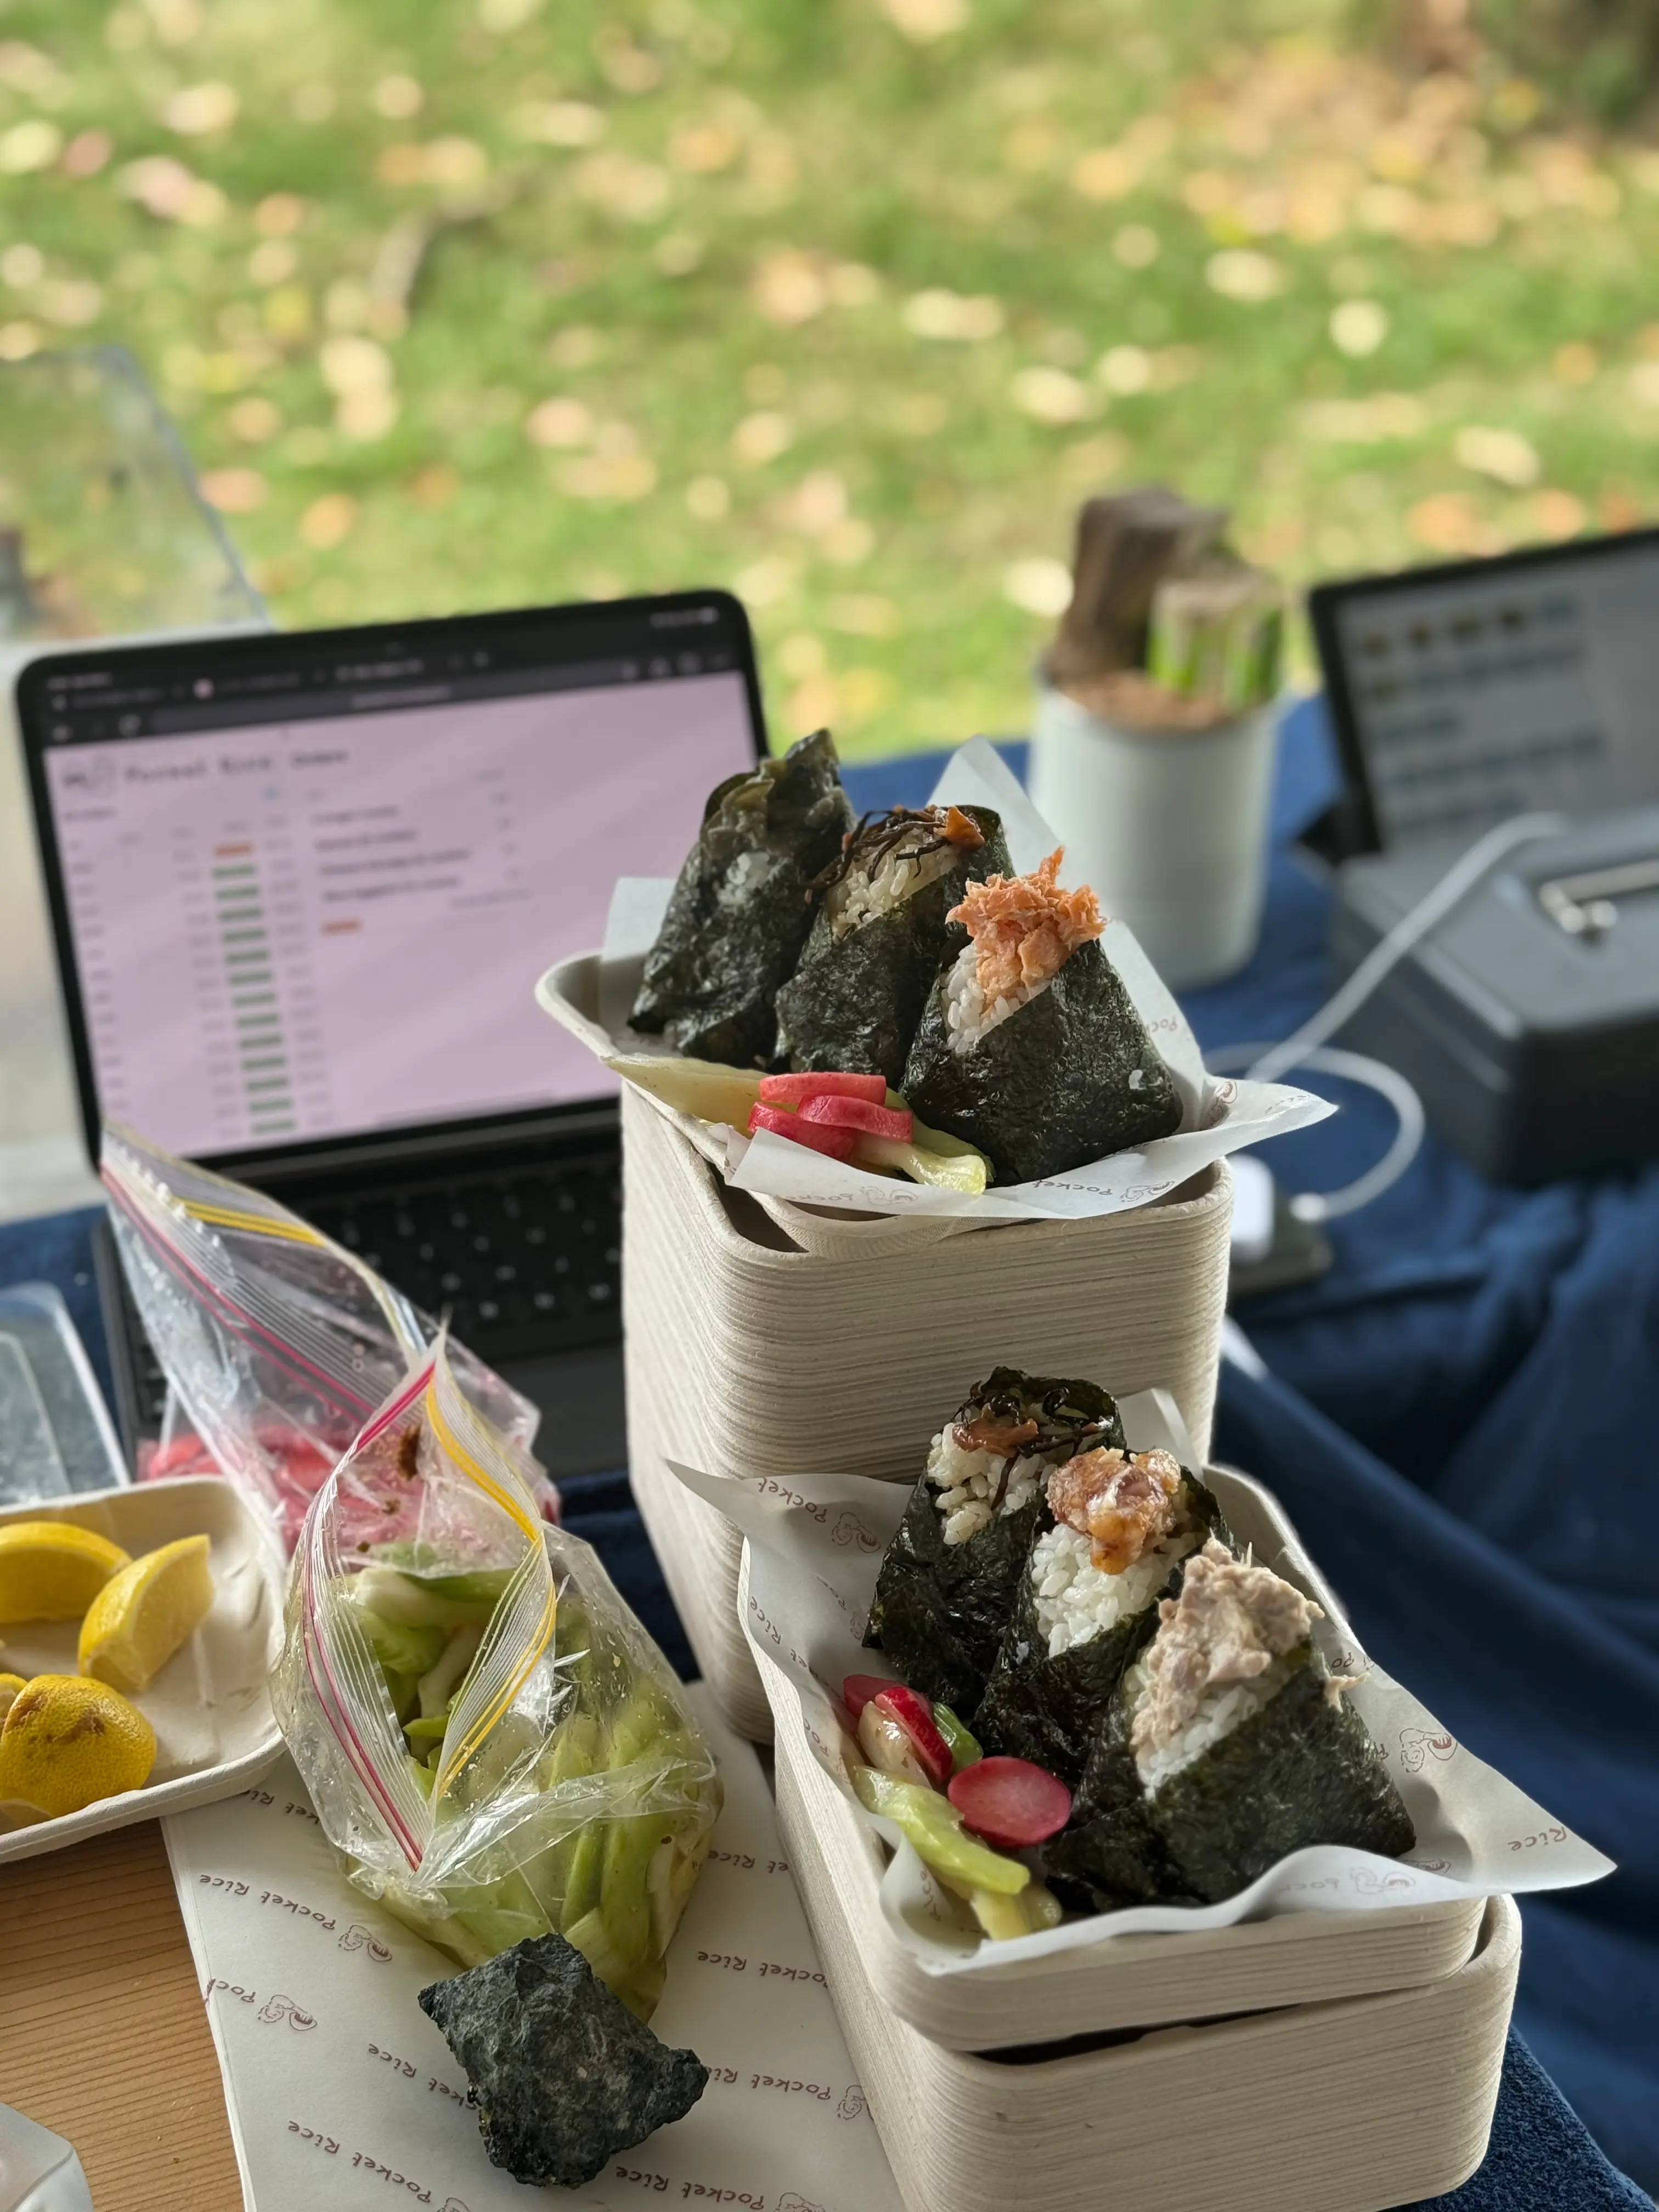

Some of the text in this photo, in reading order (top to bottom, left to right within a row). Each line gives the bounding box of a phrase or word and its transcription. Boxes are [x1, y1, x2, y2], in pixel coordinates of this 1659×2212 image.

[1032, 1178, 1113, 1197] Pocket
[758, 1477, 827, 1523] Pocket
[749, 1596, 782, 1645] Rice
[285, 1802, 320, 1825] ket
[1508, 1826, 1567, 1851] Rice
[708, 1849, 755, 1869] Rice
[200, 1874, 336, 1930] Pocket Rice
[698, 1951, 747, 1971] Rice
[369, 2044, 416, 2078] Rice
[708, 2067, 831, 2100] Pocket Ri
[288, 2120, 431, 2203] Pocket Rice
[617, 2166, 764, 2210] Pocket Rice
